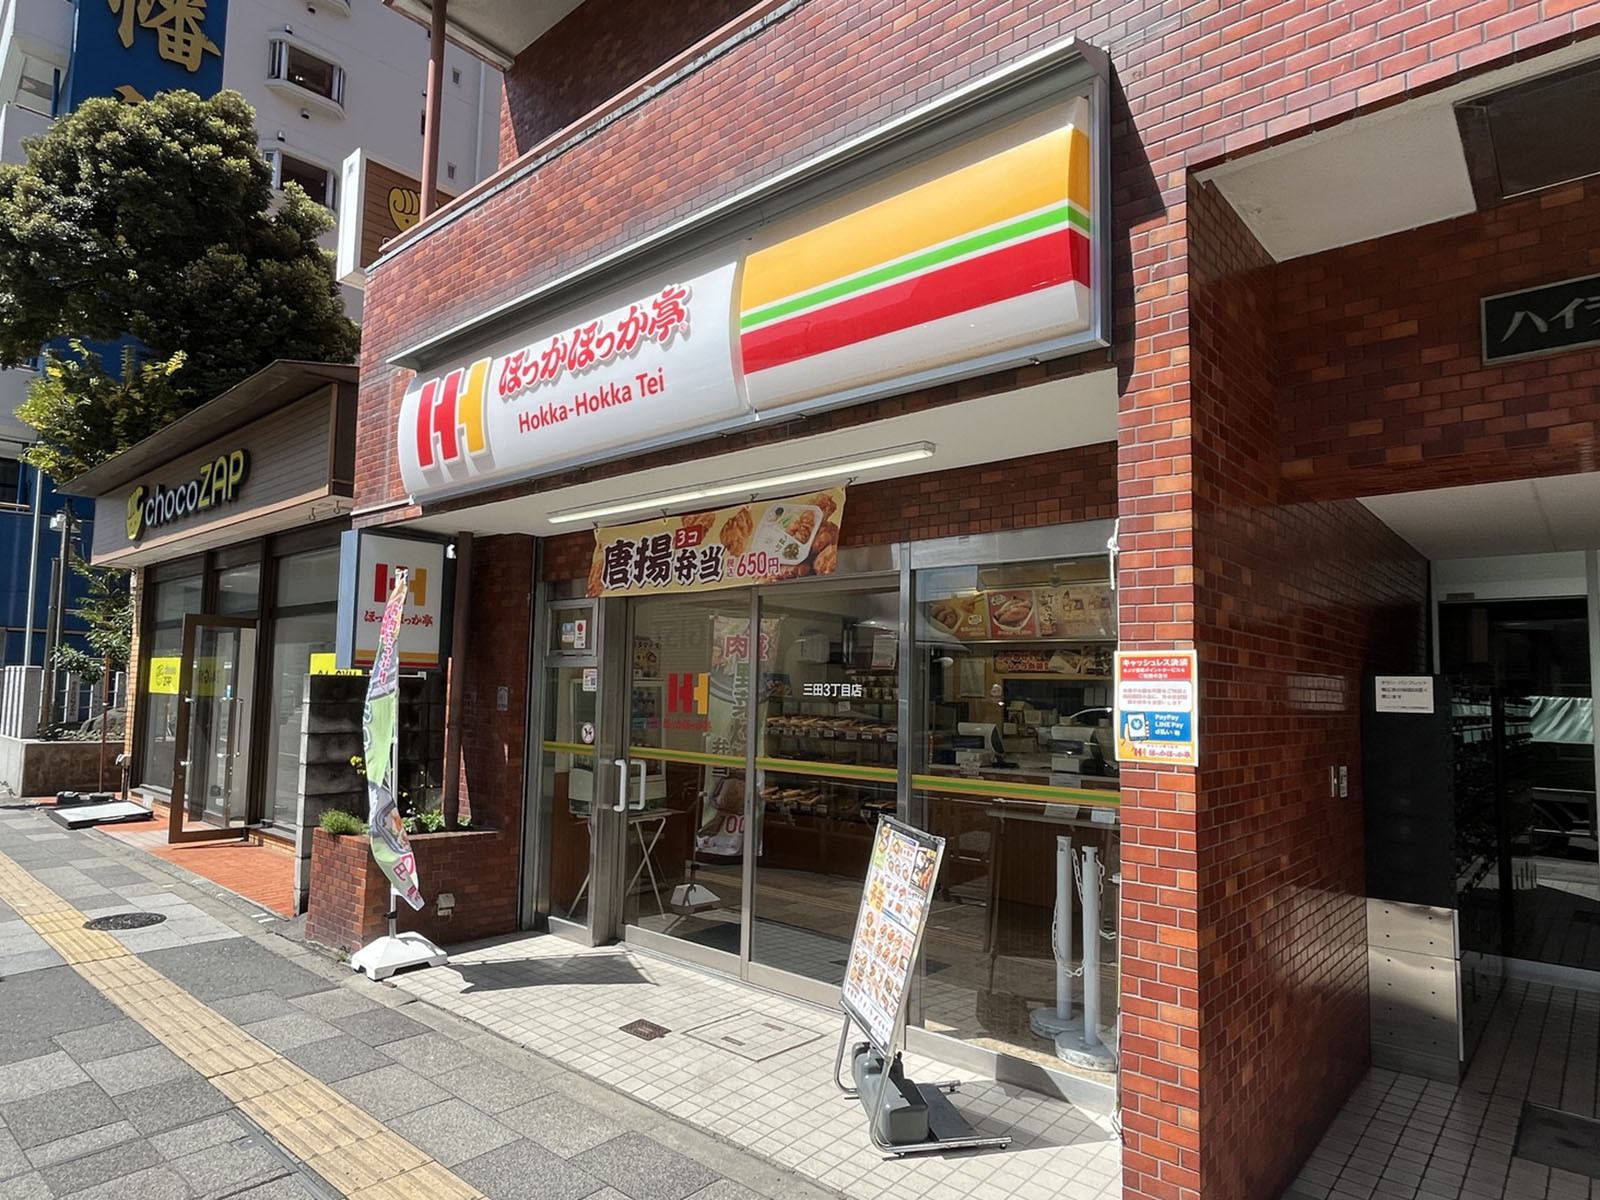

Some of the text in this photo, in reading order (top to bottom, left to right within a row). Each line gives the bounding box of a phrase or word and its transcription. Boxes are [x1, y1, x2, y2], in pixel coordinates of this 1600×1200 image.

[499, 286, 686, 396] ほっかほっか亭
[518, 367, 665, 433] Hokka-Hokka Tei
[145, 449, 244, 525] chocoZAP
[736, 551, 781, 577] 650円
[803, 683, 863, 697] 三田3丁目店
[1154, 714, 1180, 722] PayPay
